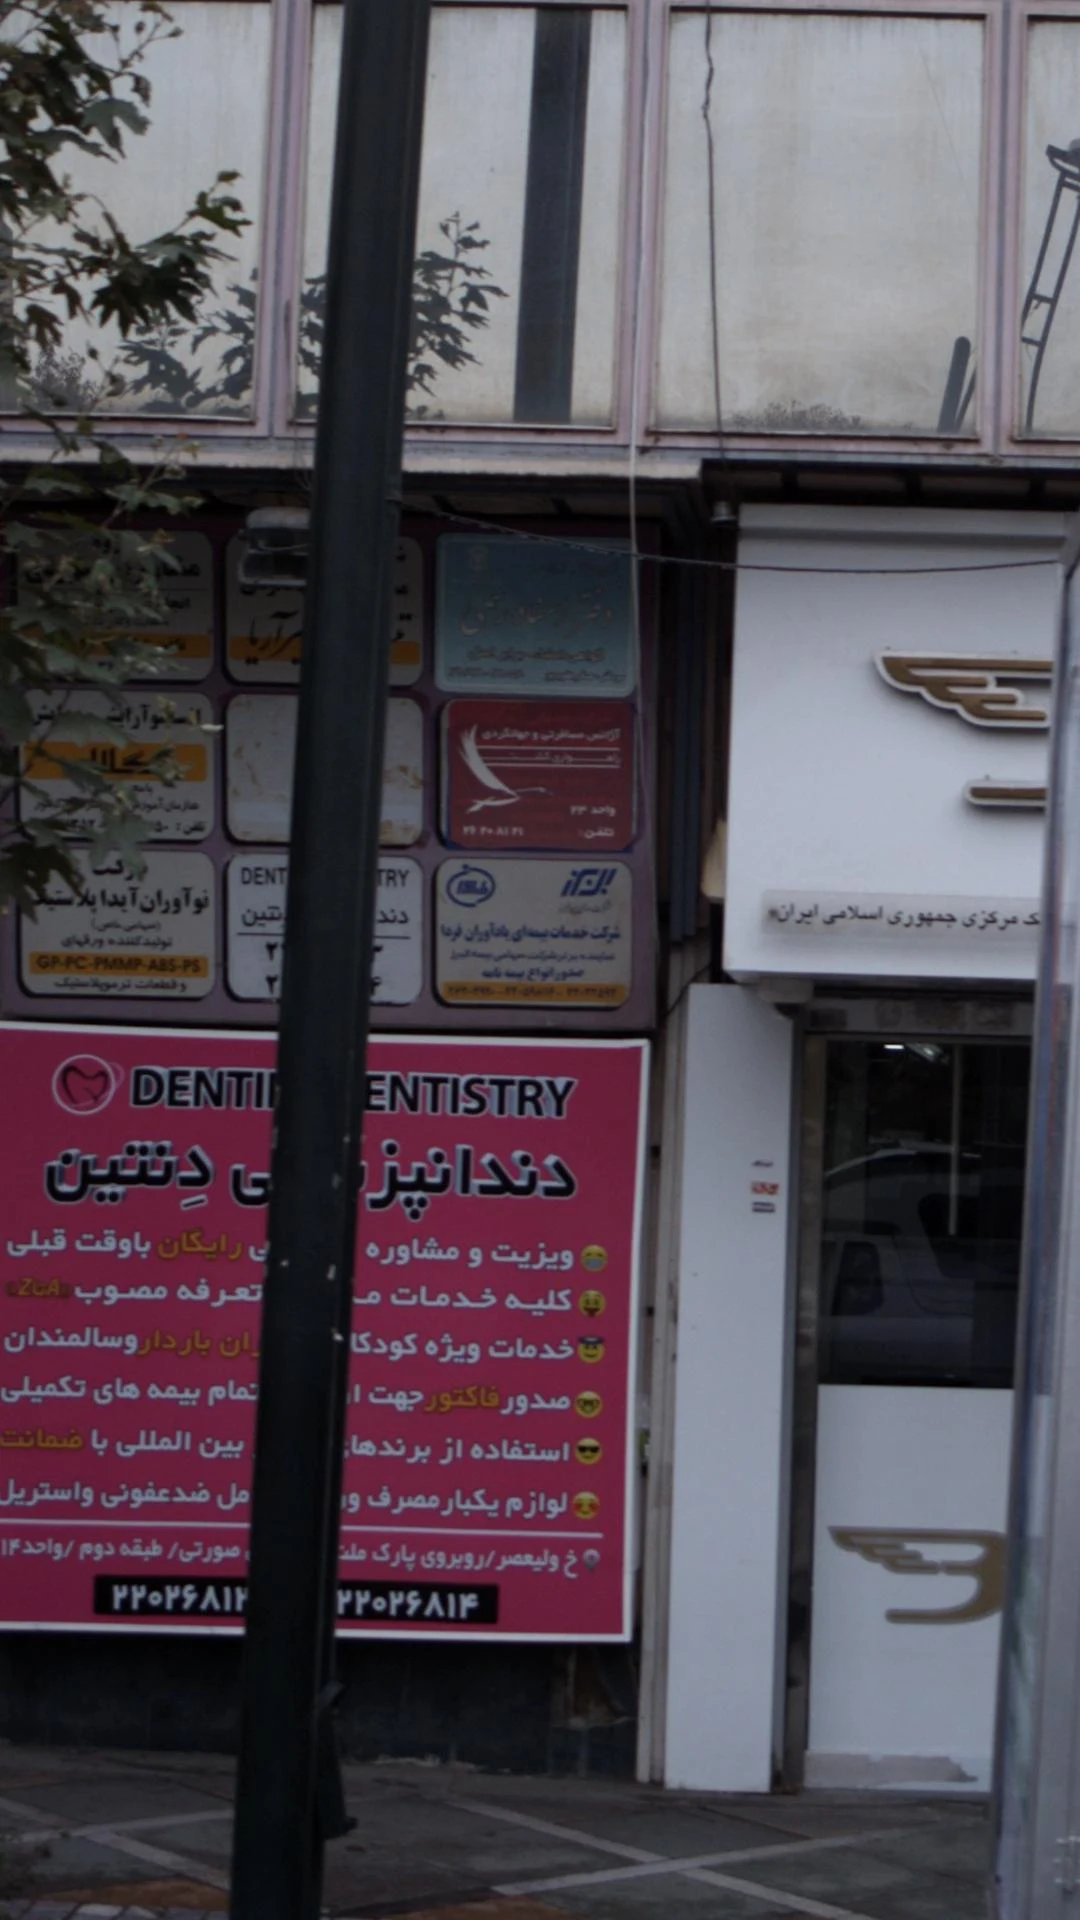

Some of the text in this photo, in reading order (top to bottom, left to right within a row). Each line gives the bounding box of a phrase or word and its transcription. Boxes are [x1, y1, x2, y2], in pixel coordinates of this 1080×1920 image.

[138, 886, 211, 915] نوآوران
[823, 904, 884, 926] اسلامی
[887, 910, 958, 930] جمهوری
[961, 910, 1020, 931] مرکزی
[364, 1071, 579, 1120] ENTISTRY
[5, 1228, 68, 1258] قبلی
[156, 1229, 244, 1264] رایگان
[364, 1237, 460, 1266] مشاوره
[489, 1241, 575, 1271] ویزیت
[467, 1248, 483, 1268] و
[73, 1284, 169, 1306] مصوب
[176, 1276, 265, 1309] تعرفه
[390, 1286, 498, 1310] خدمات
[503, 1288, 573, 1317] کلیه
[350, 1331, 419, 1362] کودکا
[424, 1332, 482, 1364] ویژه
[487, 1337, 575, 1361] خدمات
[0, 1375, 88, 1404] تکمیلی
[93, 1377, 141, 1405] های
[147, 1383, 201, 1406] بیمه
[367, 1385, 425, 1413] جهت
[422, 1385, 501, 1414] فاکتور
[500, 1390, 572, 1416] صدور
[0, 1427, 83, 1450] ضمانت
[90, 1428, 109, 1457] با
[114, 1429, 192, 1458] المللی
[198, 1435, 246, 1459] بین
[437, 1436, 464, 1466] از
[469, 1439, 570, 1464] استفاده
[504, 1491, 569, 1520] لوازم
[79, 1541, 116, 1561] دوم
[119, 1538, 165, 1561] طبقه
[371, 1543, 418, 1573] پارک
[563, 1548, 579, 1580] خ
